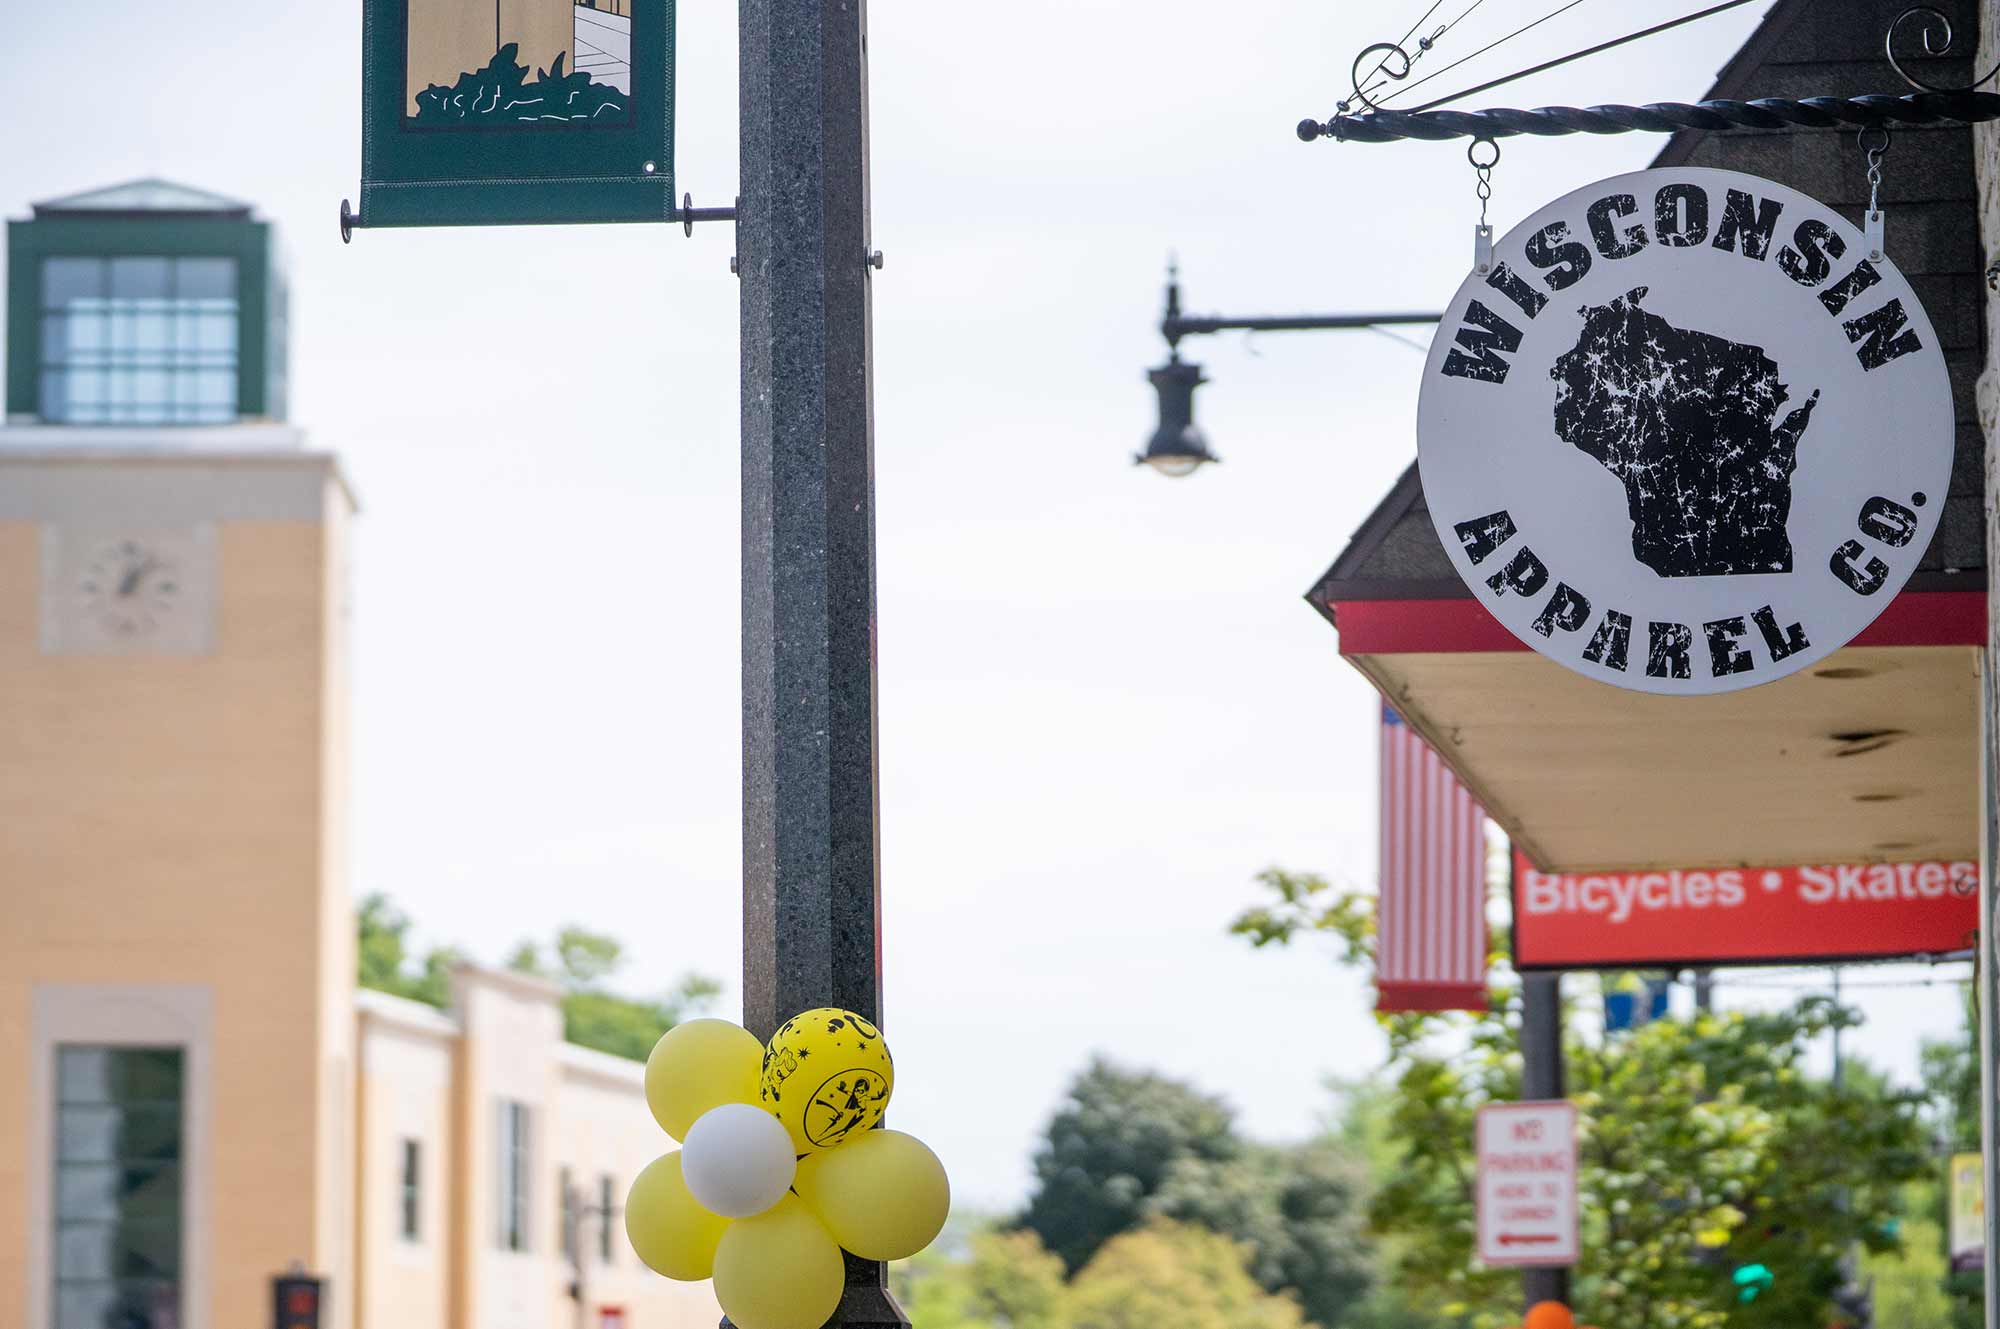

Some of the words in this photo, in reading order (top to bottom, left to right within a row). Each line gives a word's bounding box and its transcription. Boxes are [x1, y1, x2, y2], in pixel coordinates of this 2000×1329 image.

[1441, 183, 1923, 384] WISCONSIN
[1453, 509, 1811, 680] APPAREL
[1829, 491, 1927, 596] CO.
[1523, 869, 1746, 923] Bicycles
[1799, 860, 1978, 903] Skates
[1511, 1119, 1545, 1142] NO
